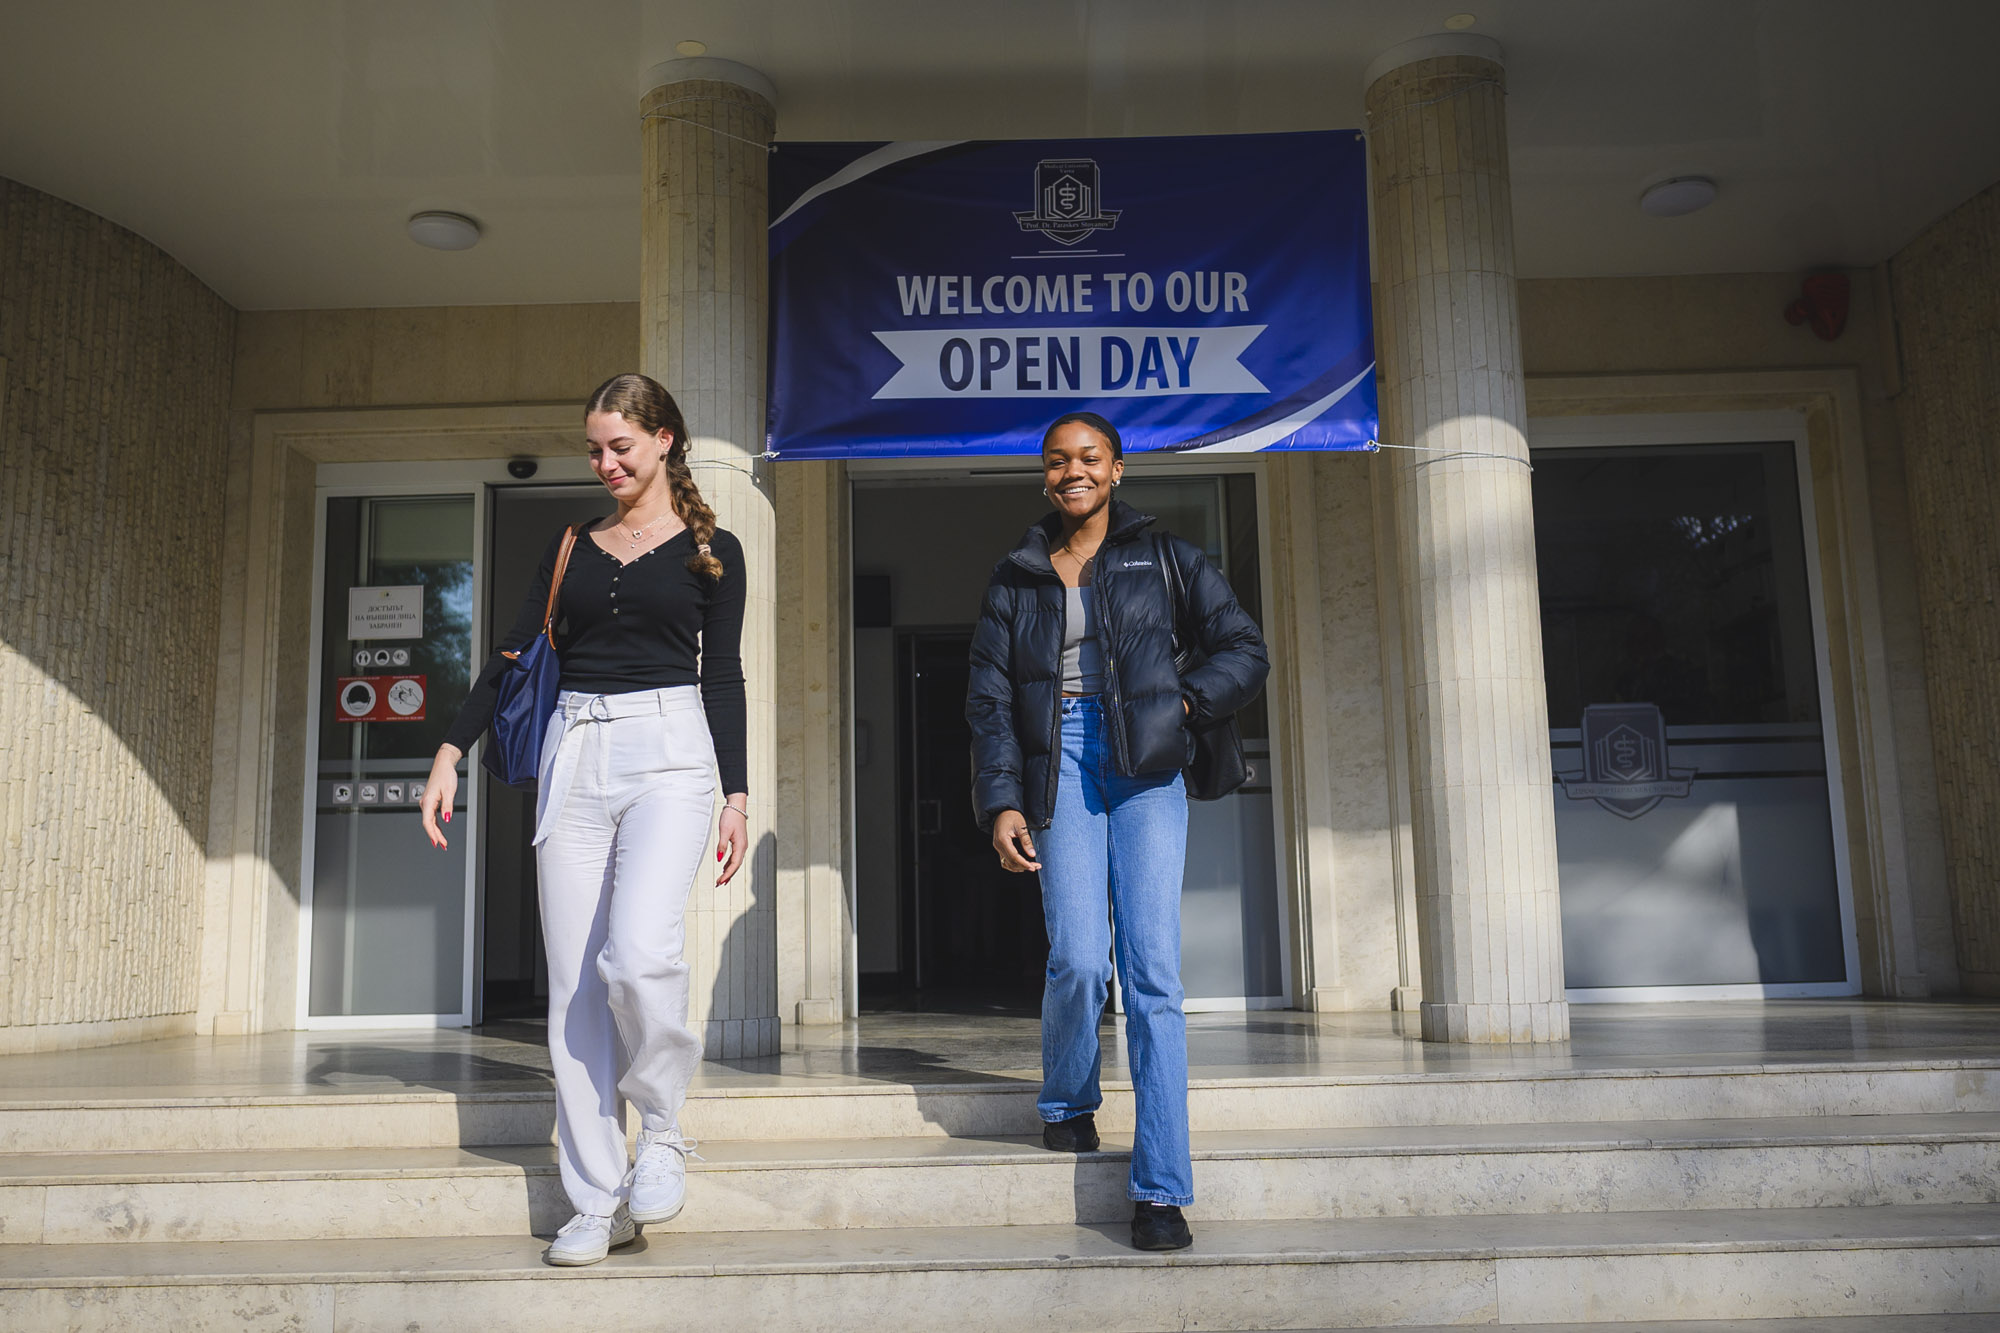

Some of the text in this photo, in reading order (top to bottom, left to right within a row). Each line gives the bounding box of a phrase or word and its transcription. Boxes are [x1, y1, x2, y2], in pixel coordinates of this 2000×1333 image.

[897, 271, 1249, 316] WELCOME TO OUR
[939, 336, 1200, 392] OPEN DAY
